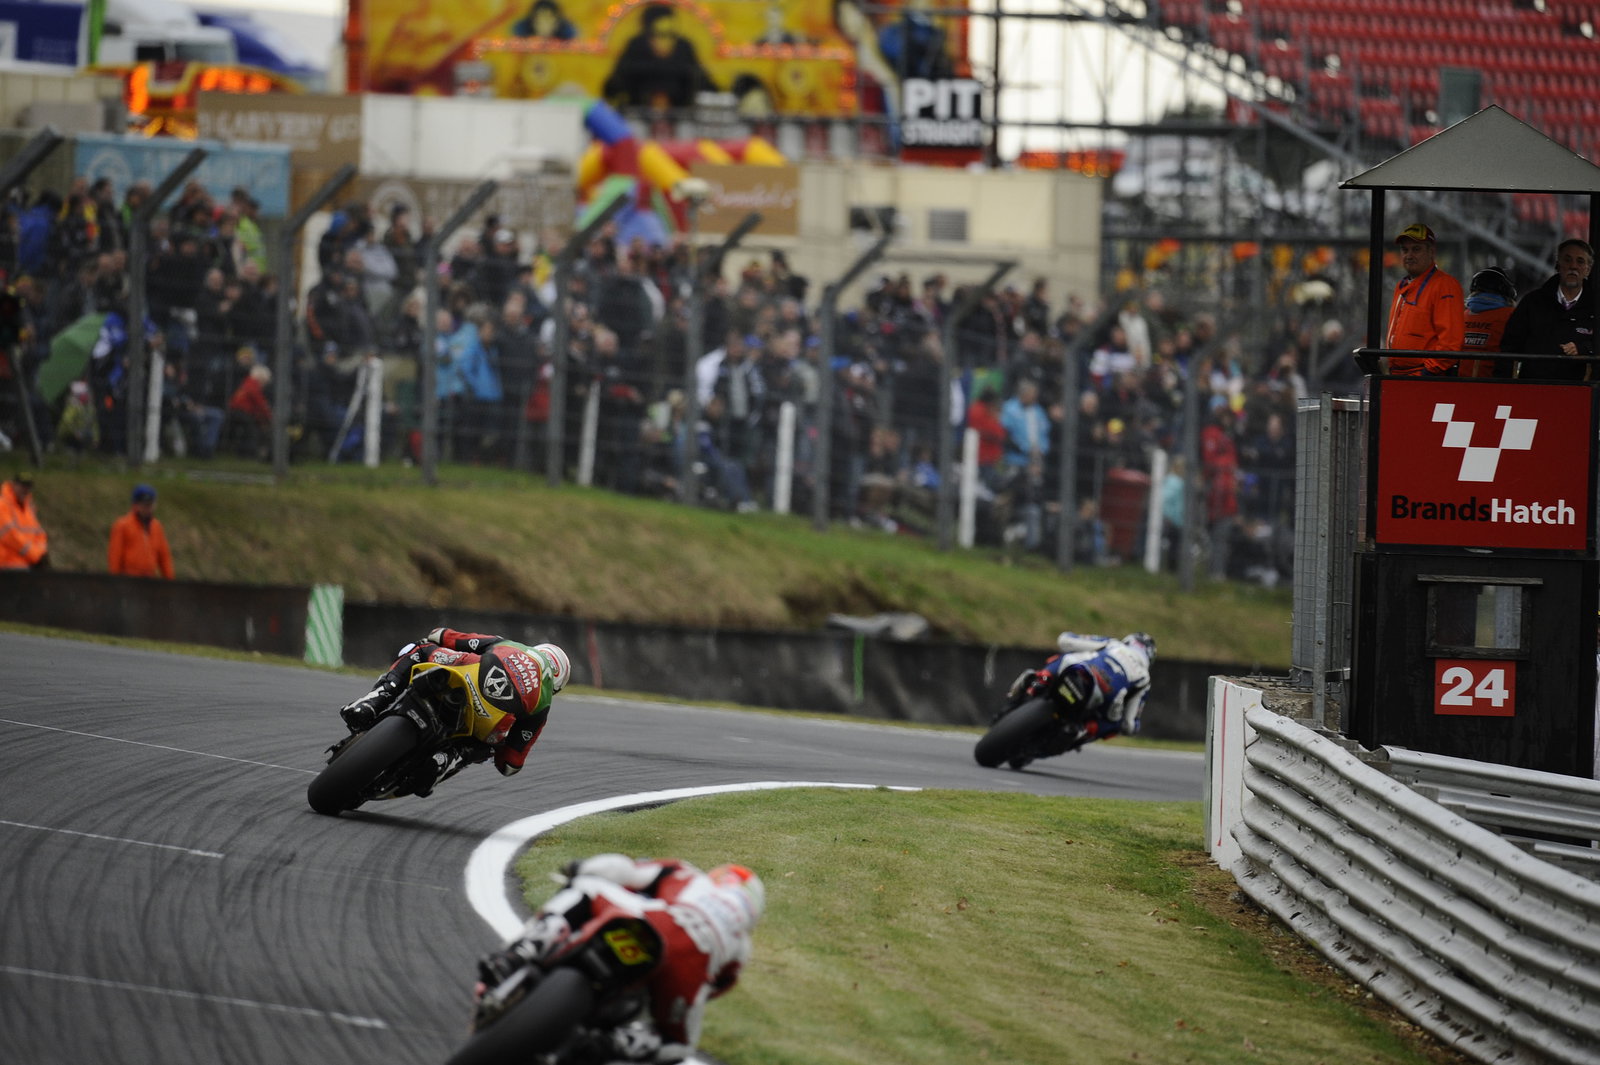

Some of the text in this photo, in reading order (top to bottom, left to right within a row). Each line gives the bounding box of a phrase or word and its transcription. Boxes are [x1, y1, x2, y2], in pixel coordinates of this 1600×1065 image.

[903, 79, 980, 119] PIT
[508, 654, 532, 694] YAMAHA
[517, 652, 538, 688] SWAN
[1440, 667, 1509, 708] 24
